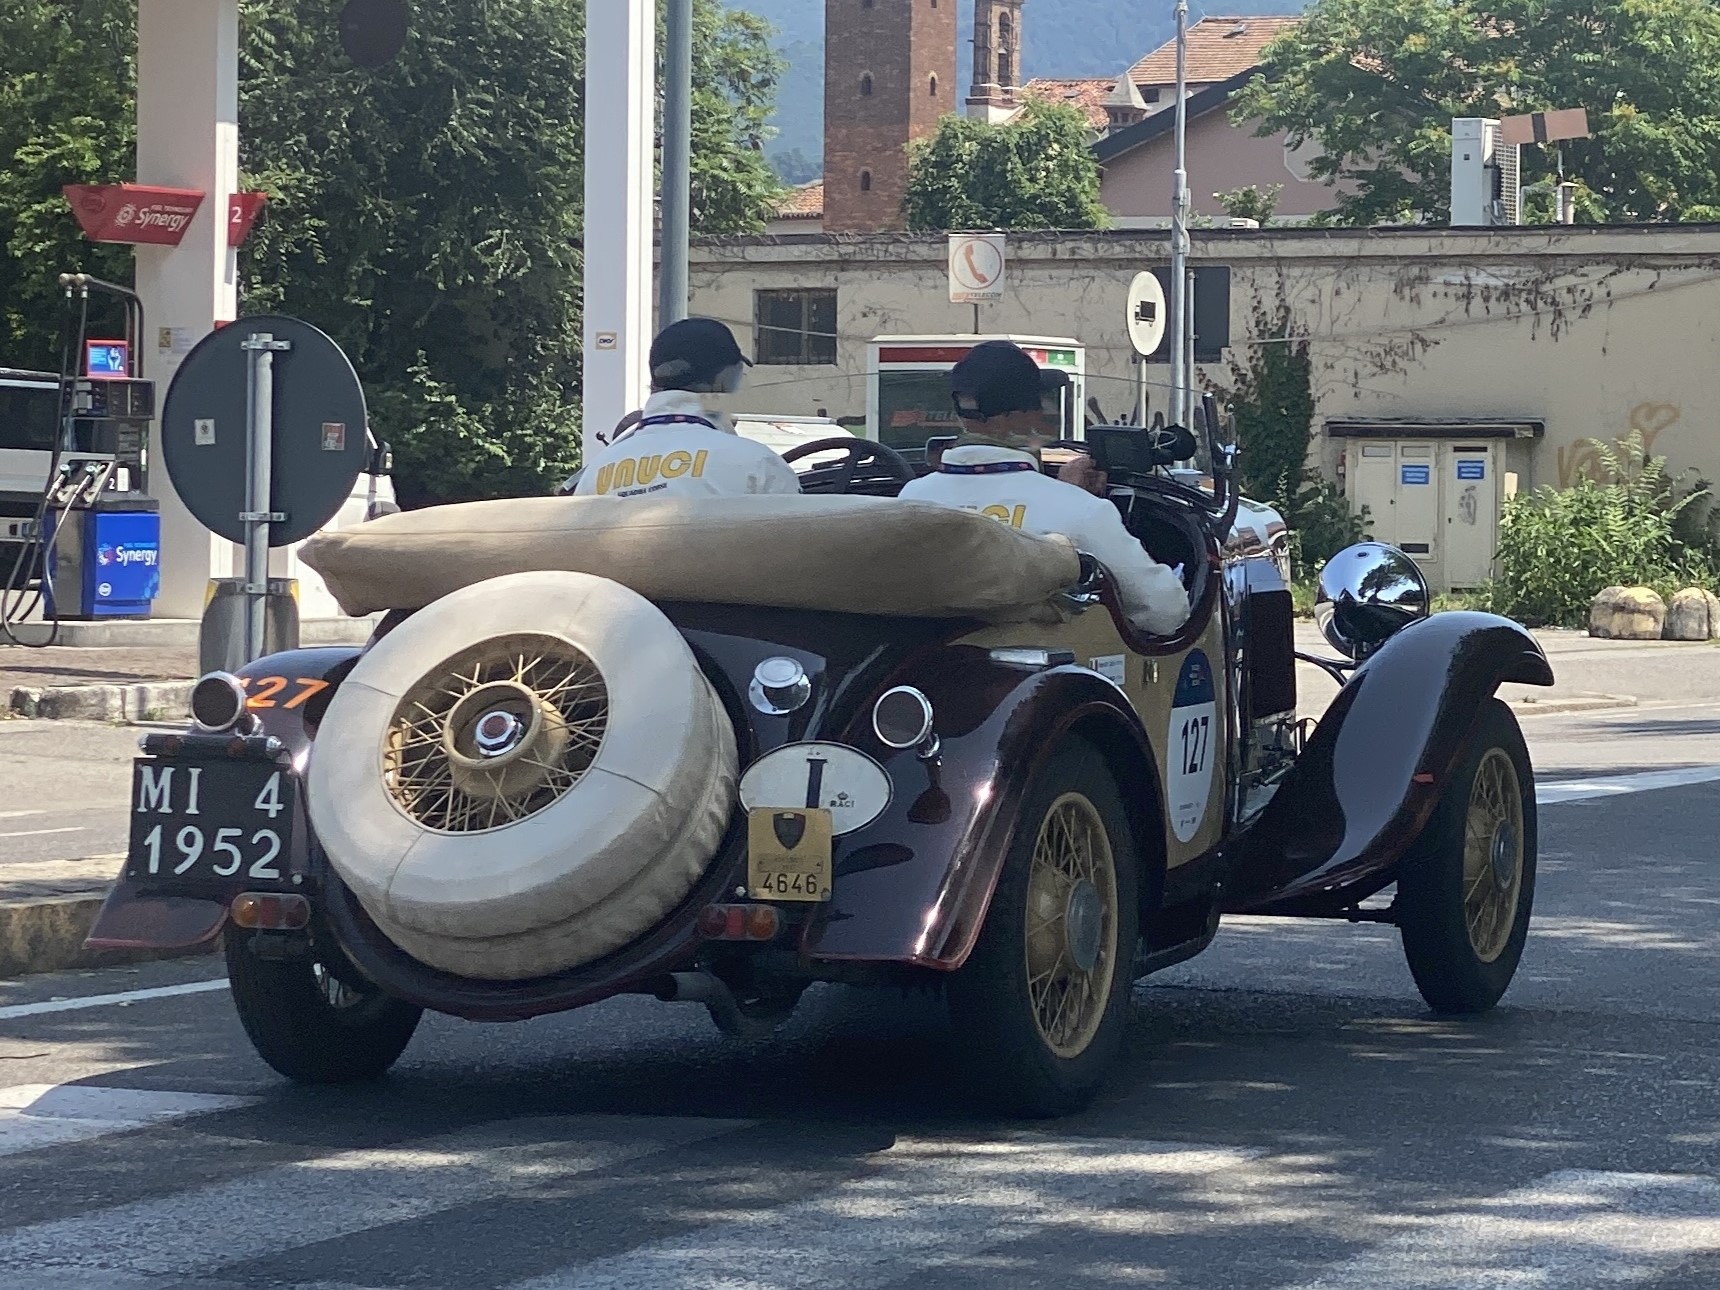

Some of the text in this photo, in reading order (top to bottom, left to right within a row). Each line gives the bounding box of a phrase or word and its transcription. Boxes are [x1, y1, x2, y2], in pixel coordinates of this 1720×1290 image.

[135, 207, 189, 232] Synergy
[231, 206, 242, 223] 2
[108, 477, 116, 490] 2
[115, 546, 158, 566] Synergy
[1181, 715, 1210, 776] 127
[137, 765, 284, 818] MI 4
[144, 824, 281, 879] 1952
[763, 872, 817, 894] 4646
